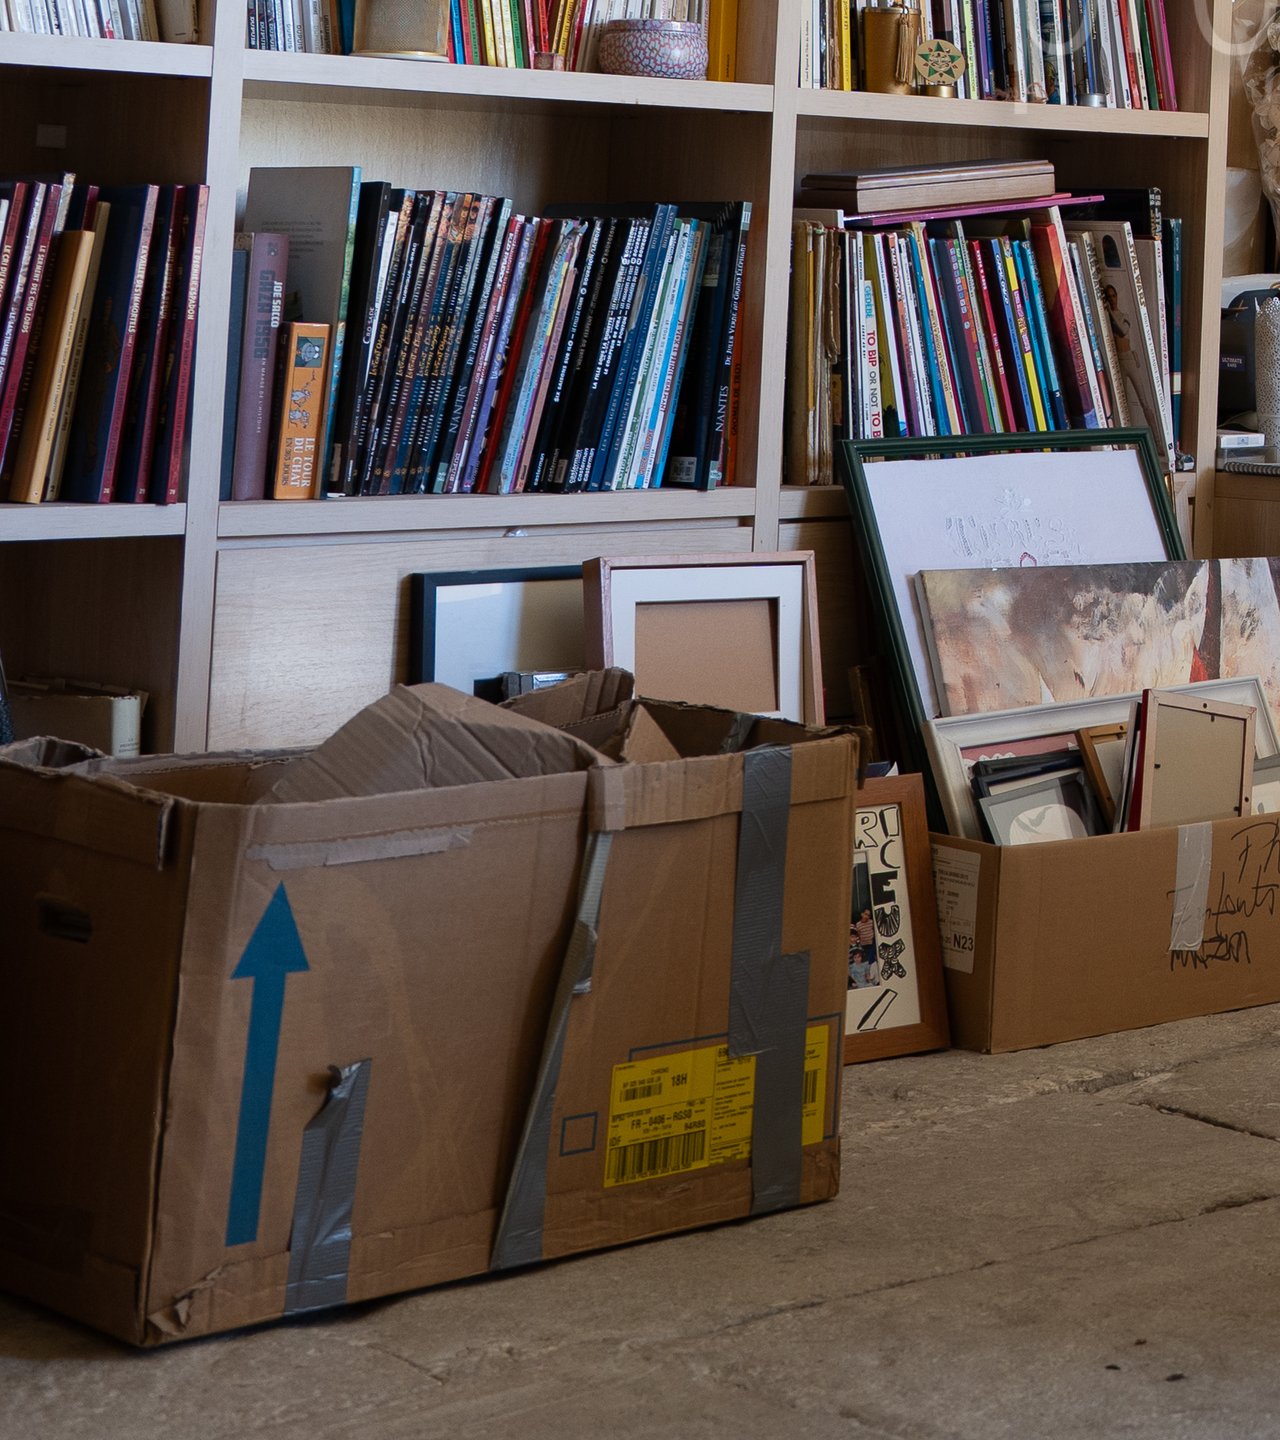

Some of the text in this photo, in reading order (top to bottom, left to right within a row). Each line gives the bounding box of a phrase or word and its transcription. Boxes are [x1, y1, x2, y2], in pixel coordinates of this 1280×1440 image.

[253, 270, 274, 358] GAZA 1956
[270, 280, 283, 327] JOE SACCO
[866, 330, 880, 426] TO BIP OR NOT TO
[449, 385, 468, 434] NANTES
[715, 385, 729, 432] NANTES
[290, 438, 304, 488] DU CHAT
[302, 438, 314, 488] LE TOUR
[533, 452, 545, 486] casterman
[953, 934, 974, 952] N23
[671, 1072, 688, 1088] 18H
